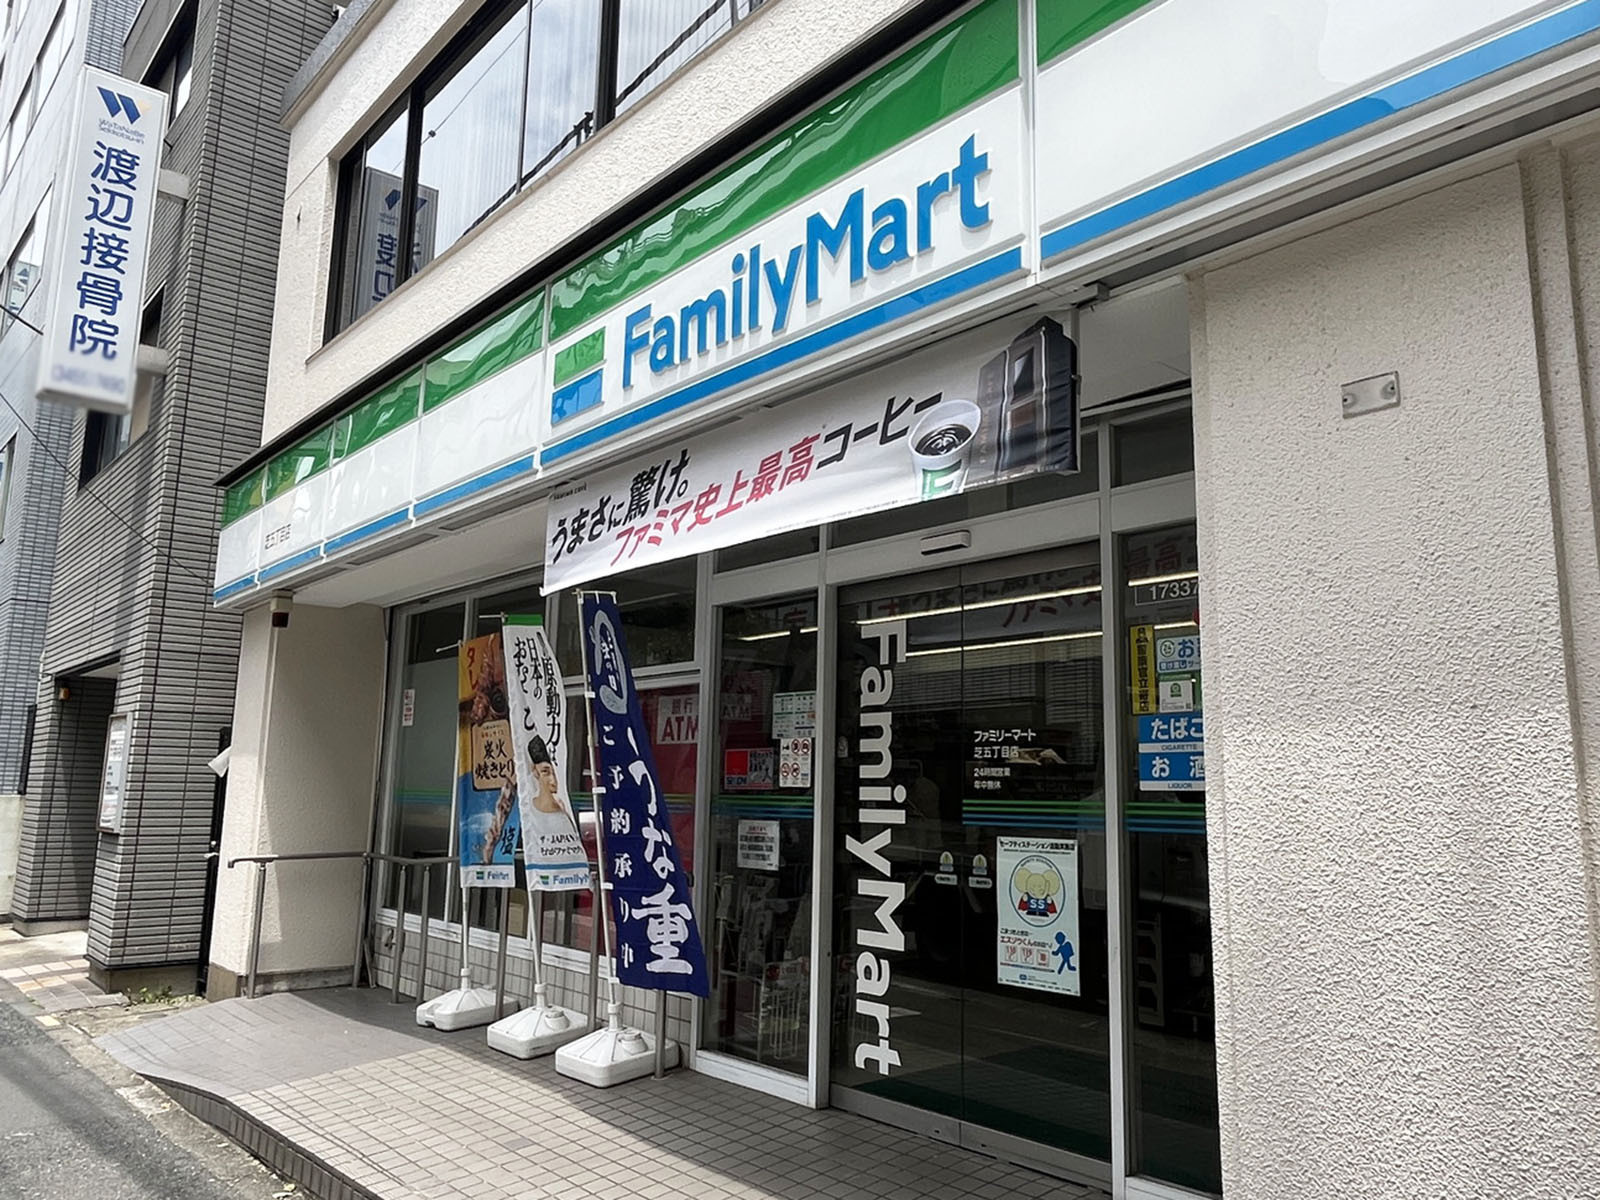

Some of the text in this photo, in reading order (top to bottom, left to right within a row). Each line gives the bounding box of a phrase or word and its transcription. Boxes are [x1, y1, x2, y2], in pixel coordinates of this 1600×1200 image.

[68, 140, 141, 362] 渡辺接骨院
[622, 133, 992, 390] FamilyMart
[610, 391, 943, 567] ファミマ史上最高コーヒー
[552, 448, 691, 565] うまさに驚け。
[661, 715, 698, 741] ATM
[973, 728, 1037, 743] ファミリーマート
[1151, 717, 1203, 740] たばこ
[484, 738, 508, 760] 炭火
[973, 745, 1020, 759] 芝五丁目店
[475, 759, 515, 780] 焼きとり
[845, 619, 907, 1076] FamilyMart
[1029, 898, 1046, 909] SS
